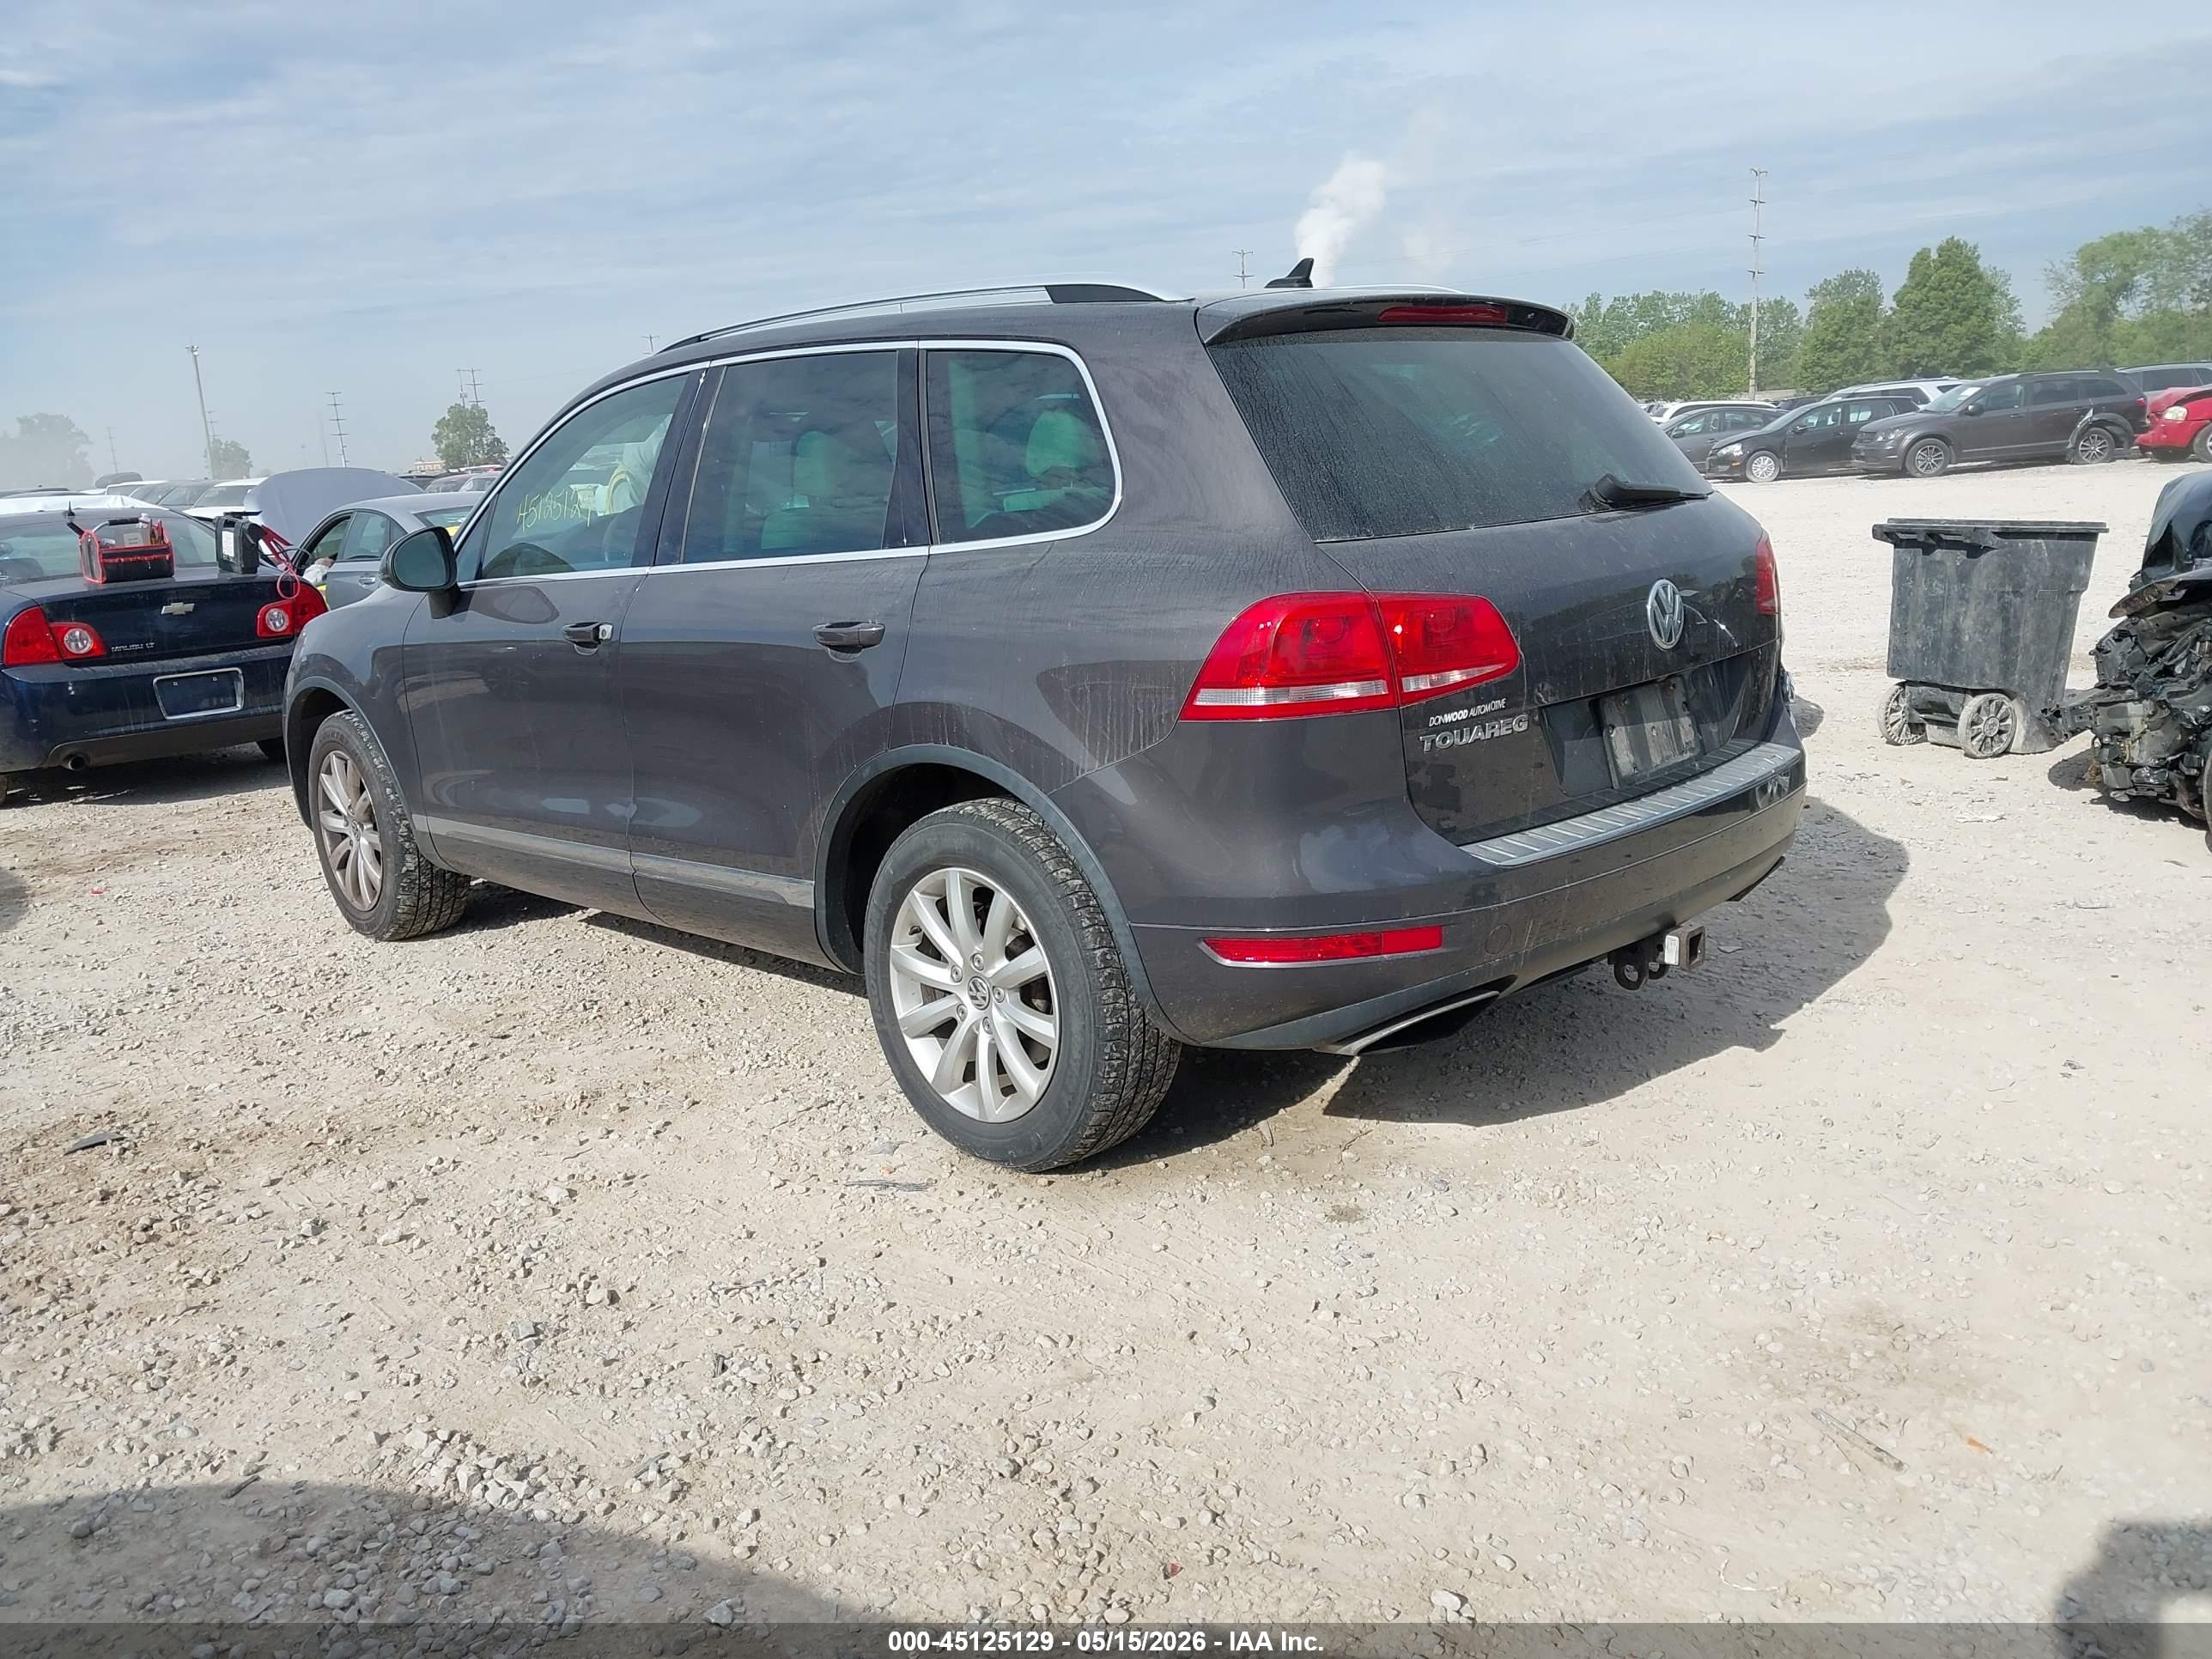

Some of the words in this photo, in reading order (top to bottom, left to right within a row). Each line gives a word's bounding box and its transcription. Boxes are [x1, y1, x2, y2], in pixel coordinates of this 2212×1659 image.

[1429, 709, 1468, 727] DONWOOD
[1468, 698, 1507, 718] AUTOMOTIVE
[1419, 714, 1528, 752] TOUAREG
